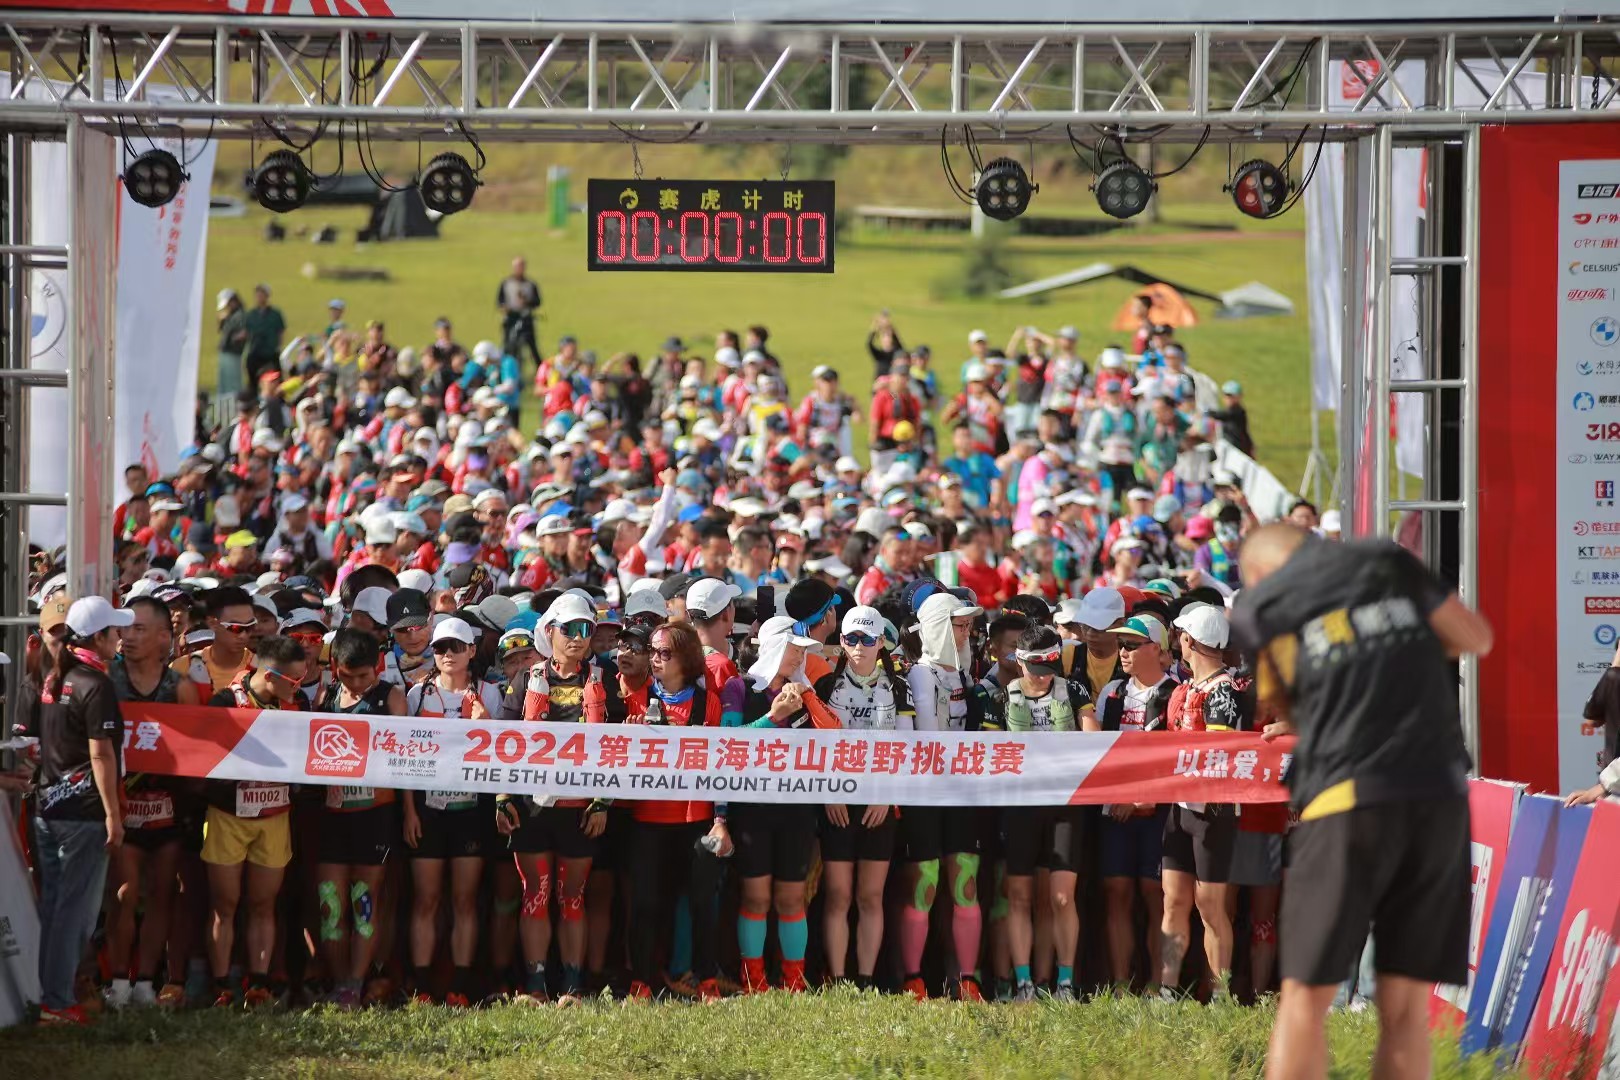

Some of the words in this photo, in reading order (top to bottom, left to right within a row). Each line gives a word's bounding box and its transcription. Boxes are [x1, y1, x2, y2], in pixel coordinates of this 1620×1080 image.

[659, 188, 804, 210] 赛虎计时
[598, 210, 826, 262] 00:00:00
[1578, 546, 1595, 557] KT
[410, 729, 434, 739] 2024
[462, 728, 589, 767] 2024
[598, 734, 1026, 776] 第五届海坨山越野挑战赛
[462, 767, 502, 782] THE
[508, 769, 547, 785] 5TH
[555, 771, 621, 788] ULTRA
[628, 773, 689, 790] TRAIL
[695, 775, 771, 792] MOUNT
[777, 777, 858, 793] HAITUO
[243, 790, 280, 804] M1002
